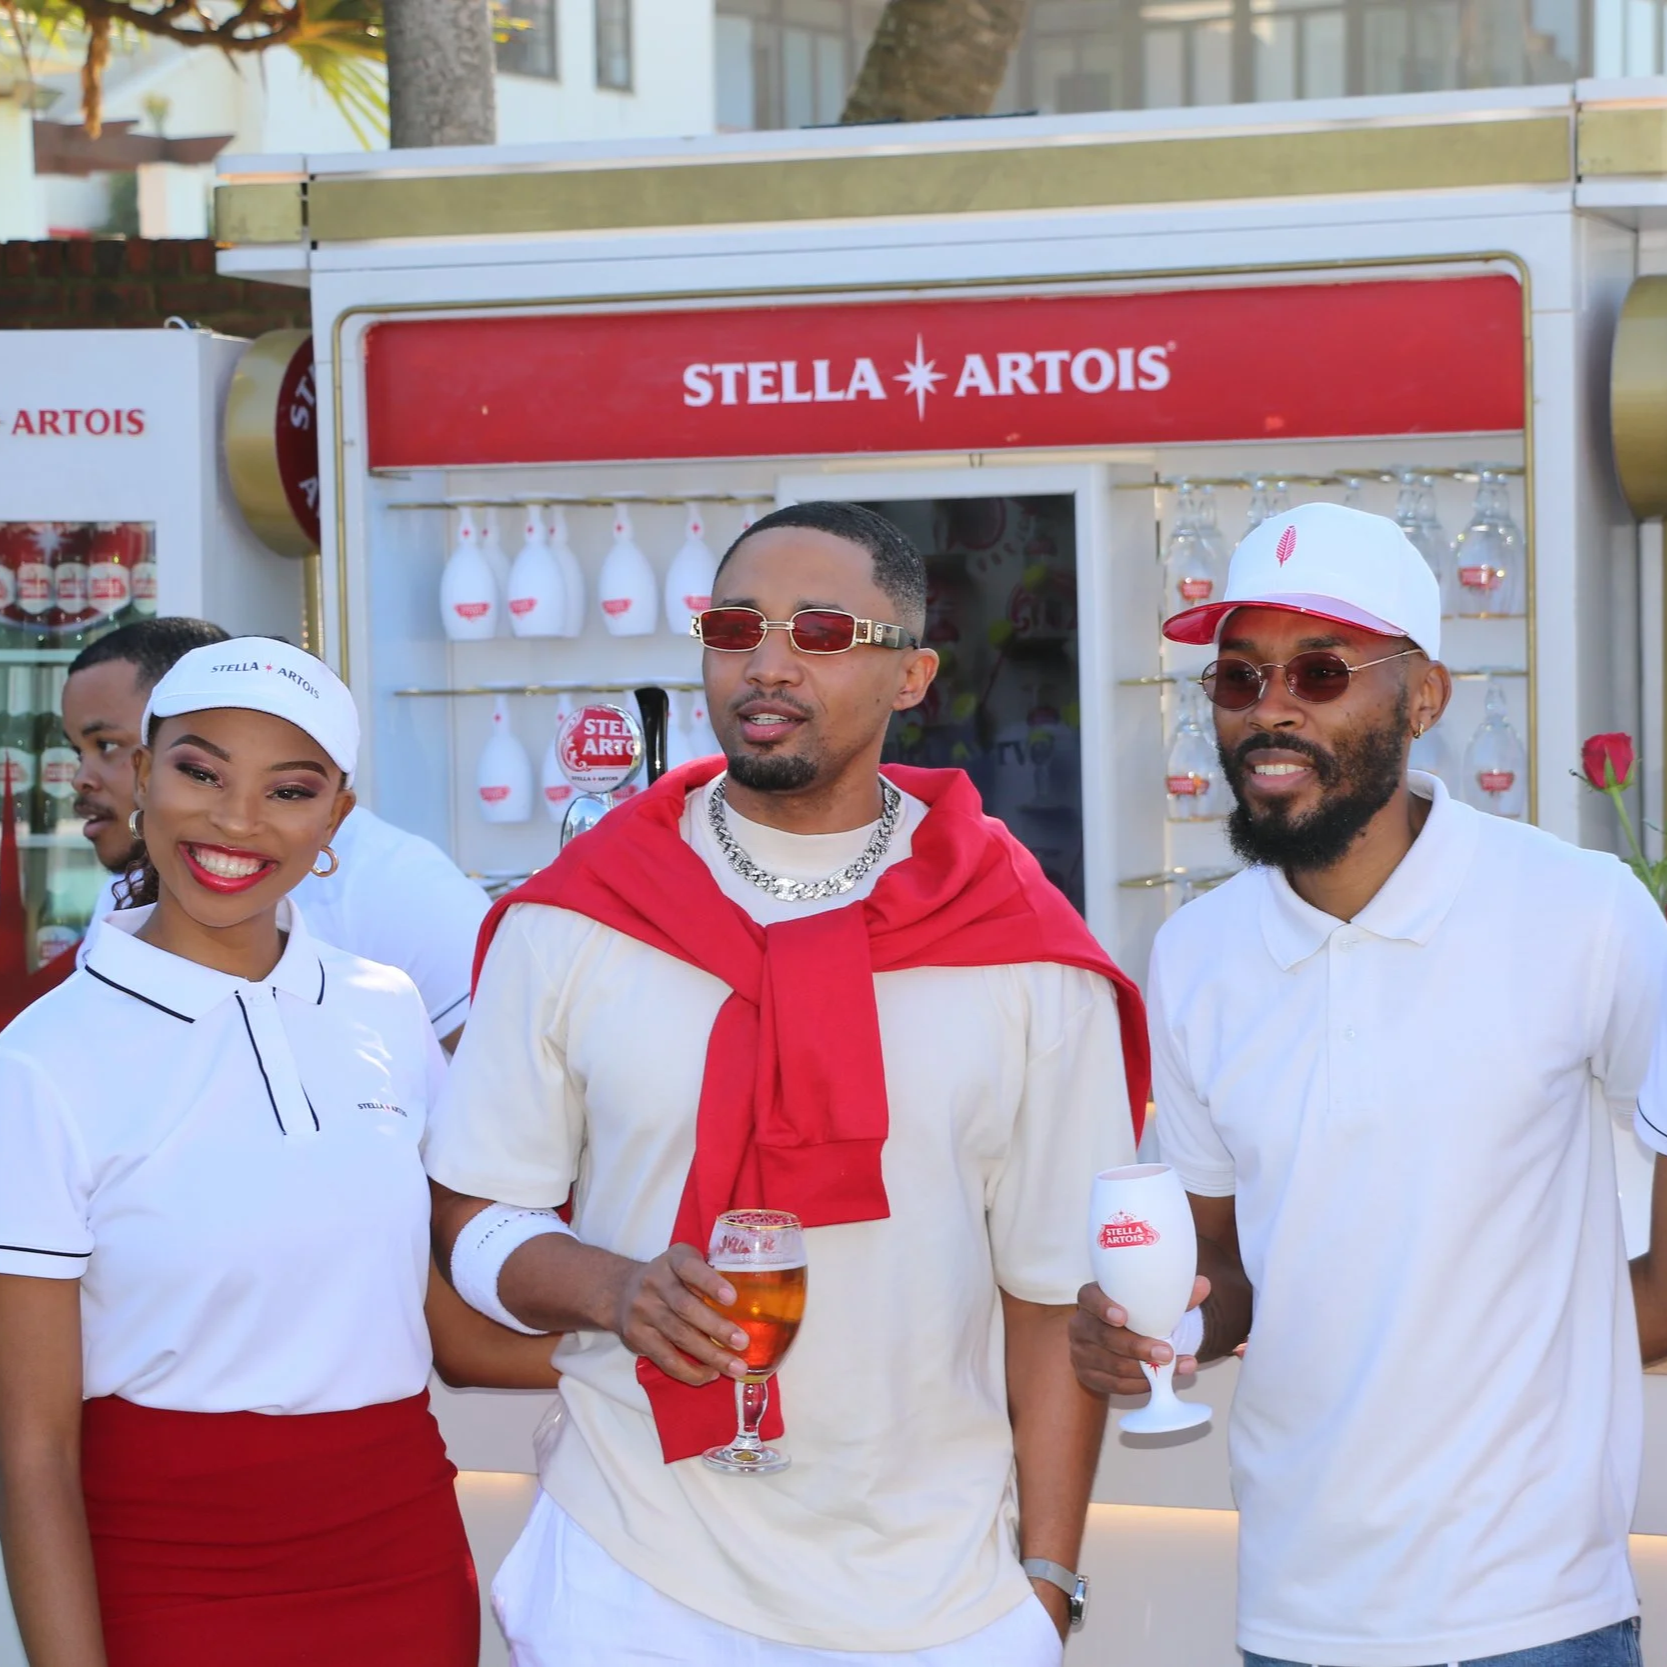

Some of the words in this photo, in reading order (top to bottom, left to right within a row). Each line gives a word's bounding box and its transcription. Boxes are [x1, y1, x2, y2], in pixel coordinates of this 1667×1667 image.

[683, 357, 887, 407] STELLA
[954, 345, 1171, 397] ARTOIS
[11, 408, 146, 436] ARTOIS
[210, 661, 260, 674] STELLA
[277, 667, 321, 700] ARTOIS
[357, 1102, 385, 1110] STELLA
[1106, 1227, 1143, 1236] STELLA
[1107, 1235, 1144, 1244] ARTOIS
